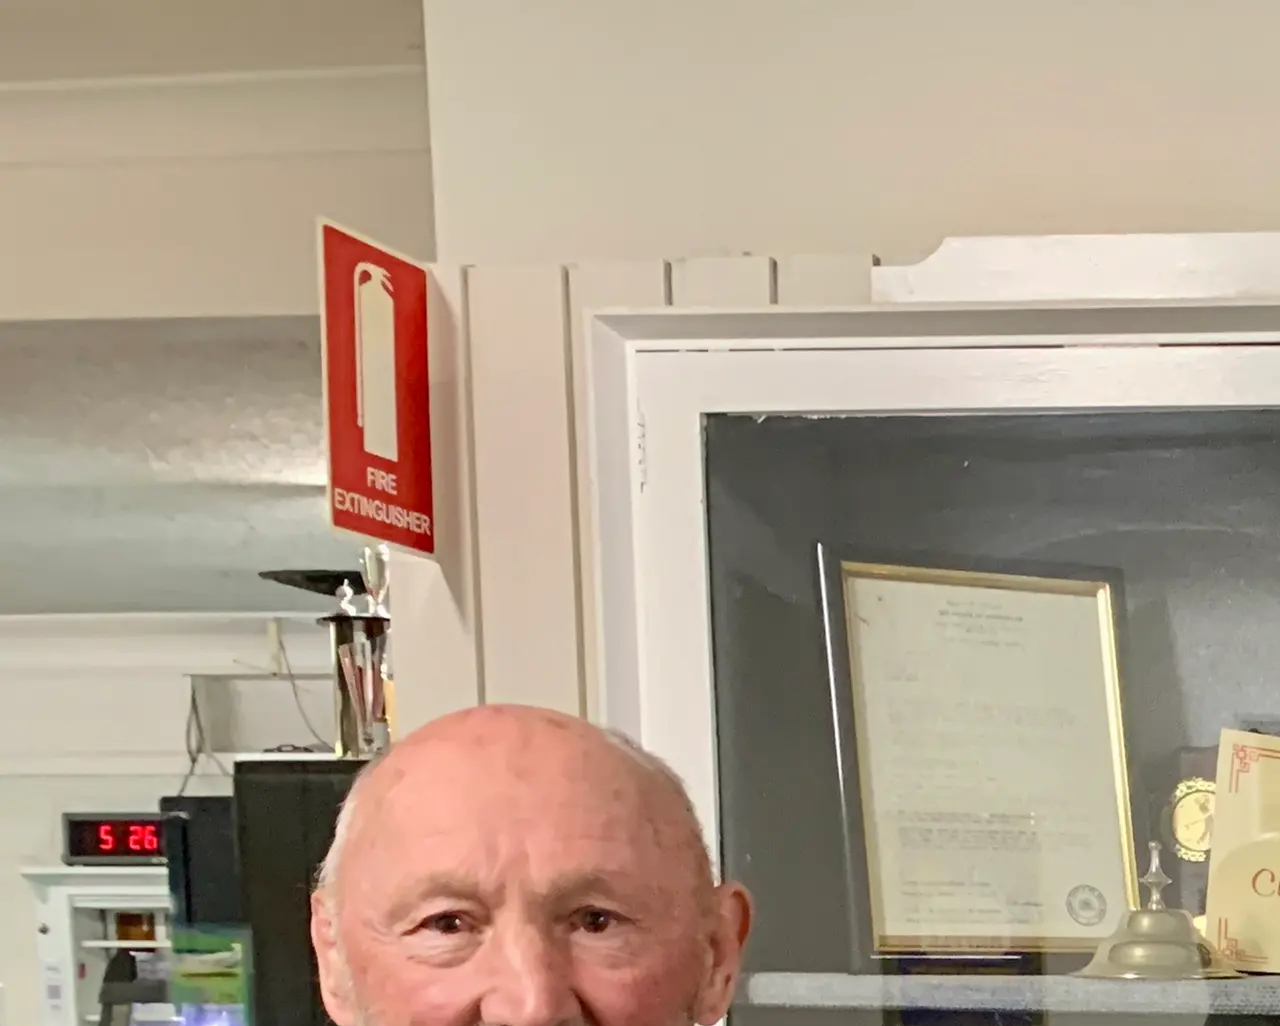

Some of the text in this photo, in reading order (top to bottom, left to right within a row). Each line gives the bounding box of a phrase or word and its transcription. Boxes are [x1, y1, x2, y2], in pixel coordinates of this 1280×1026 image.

[366, 466, 398, 496] FIRE
[334, 487, 431, 536] EXTINGUISHER
[99, 825, 157, 850] 5 26
